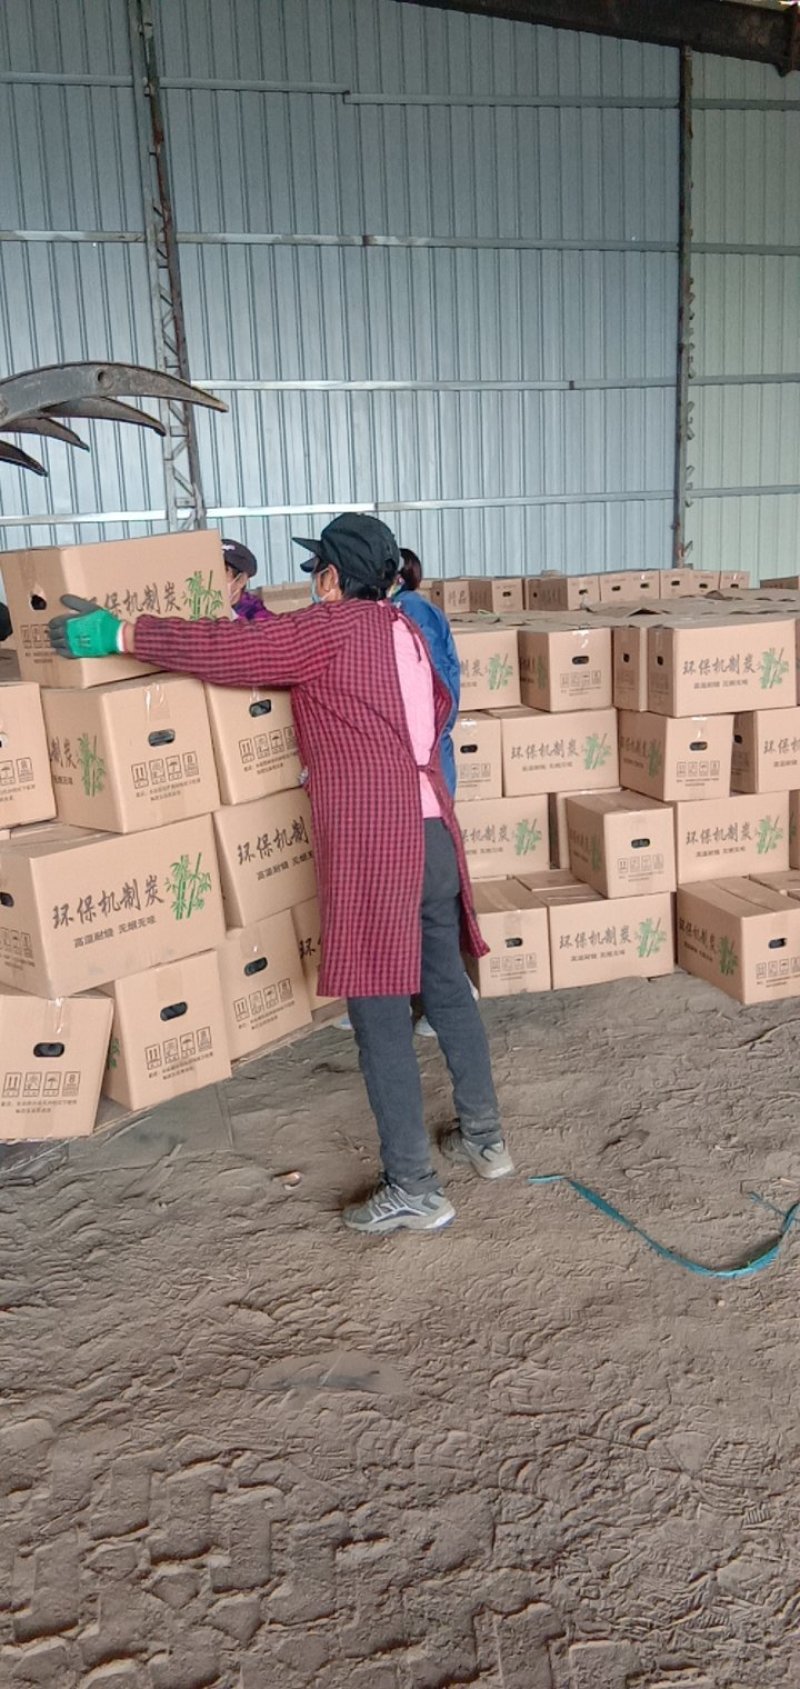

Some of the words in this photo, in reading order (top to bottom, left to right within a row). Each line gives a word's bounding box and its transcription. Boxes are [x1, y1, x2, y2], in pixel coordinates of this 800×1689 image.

[88, 581, 180, 617] 保机制炭
[52, 874, 164, 929] 环保机制炭
